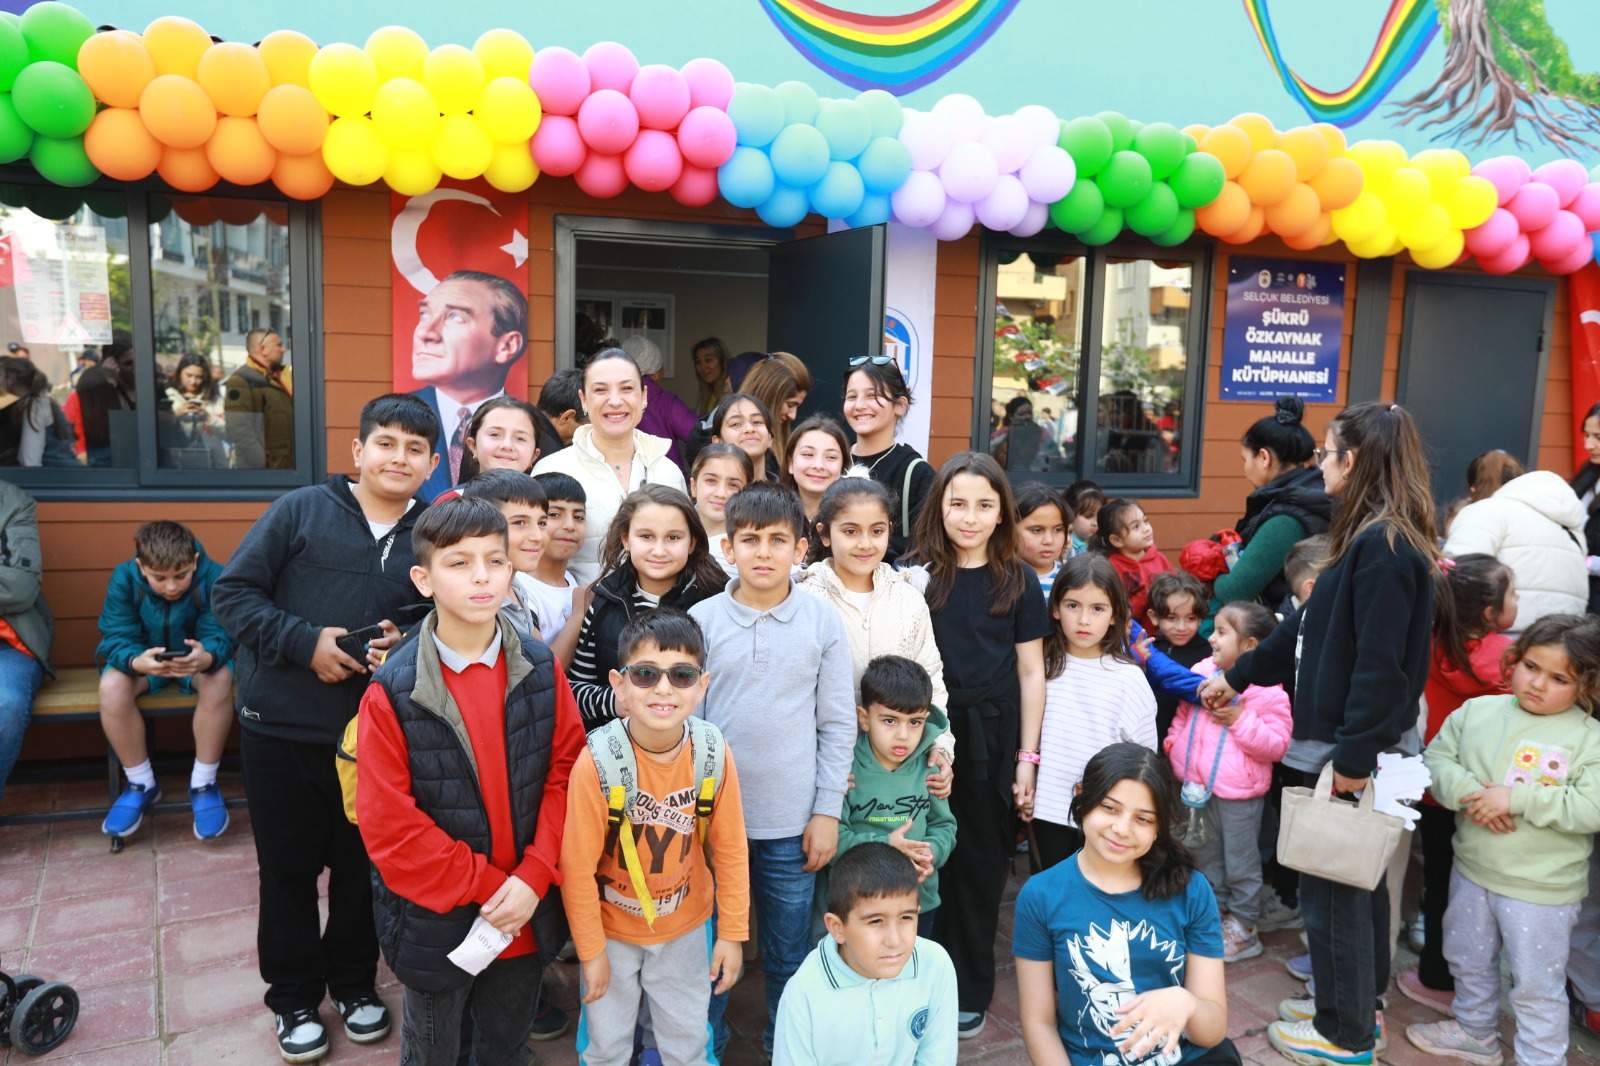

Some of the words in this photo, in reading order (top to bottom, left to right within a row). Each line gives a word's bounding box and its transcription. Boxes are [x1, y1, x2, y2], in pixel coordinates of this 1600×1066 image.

[1243, 291, 1279, 303] SELÇUK
[1280, 292, 1330, 305] BELEDİYESİ
[1262, 308, 1309, 326] ŞÜKRÜ
[1246, 326, 1322, 346] ÖZKAYNAK
[1249, 350, 1316, 365] MAHALLE
[1232, 365, 1329, 384] KÜTÜPHANESİ
